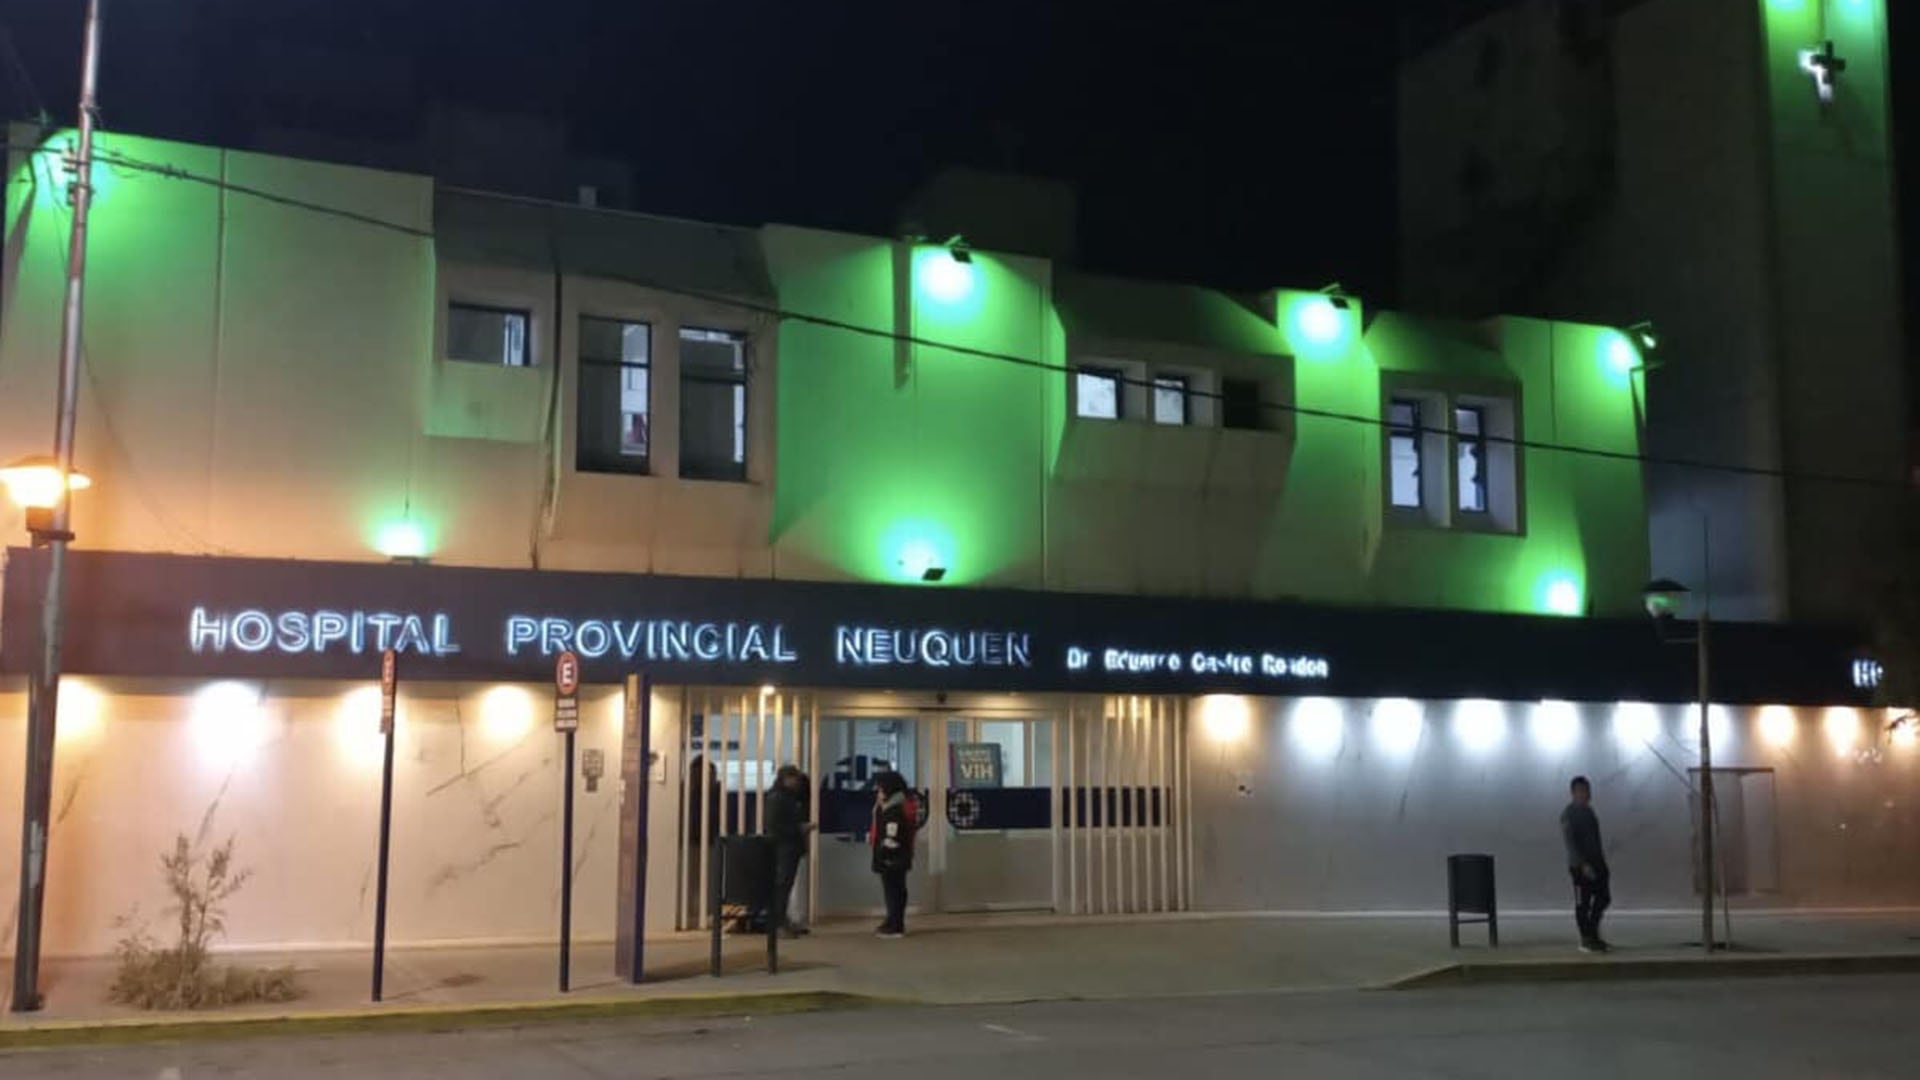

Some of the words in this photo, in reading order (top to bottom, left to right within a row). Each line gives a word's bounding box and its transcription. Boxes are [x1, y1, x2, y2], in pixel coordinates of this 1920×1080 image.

[190, 607, 460, 655] HOSPITAL
[507, 614, 797, 662] PROVINCIAL
[836, 625, 1031, 667] NEUQUEN
[562, 662, 573, 684] E
[961, 763, 994, 779] VIH
